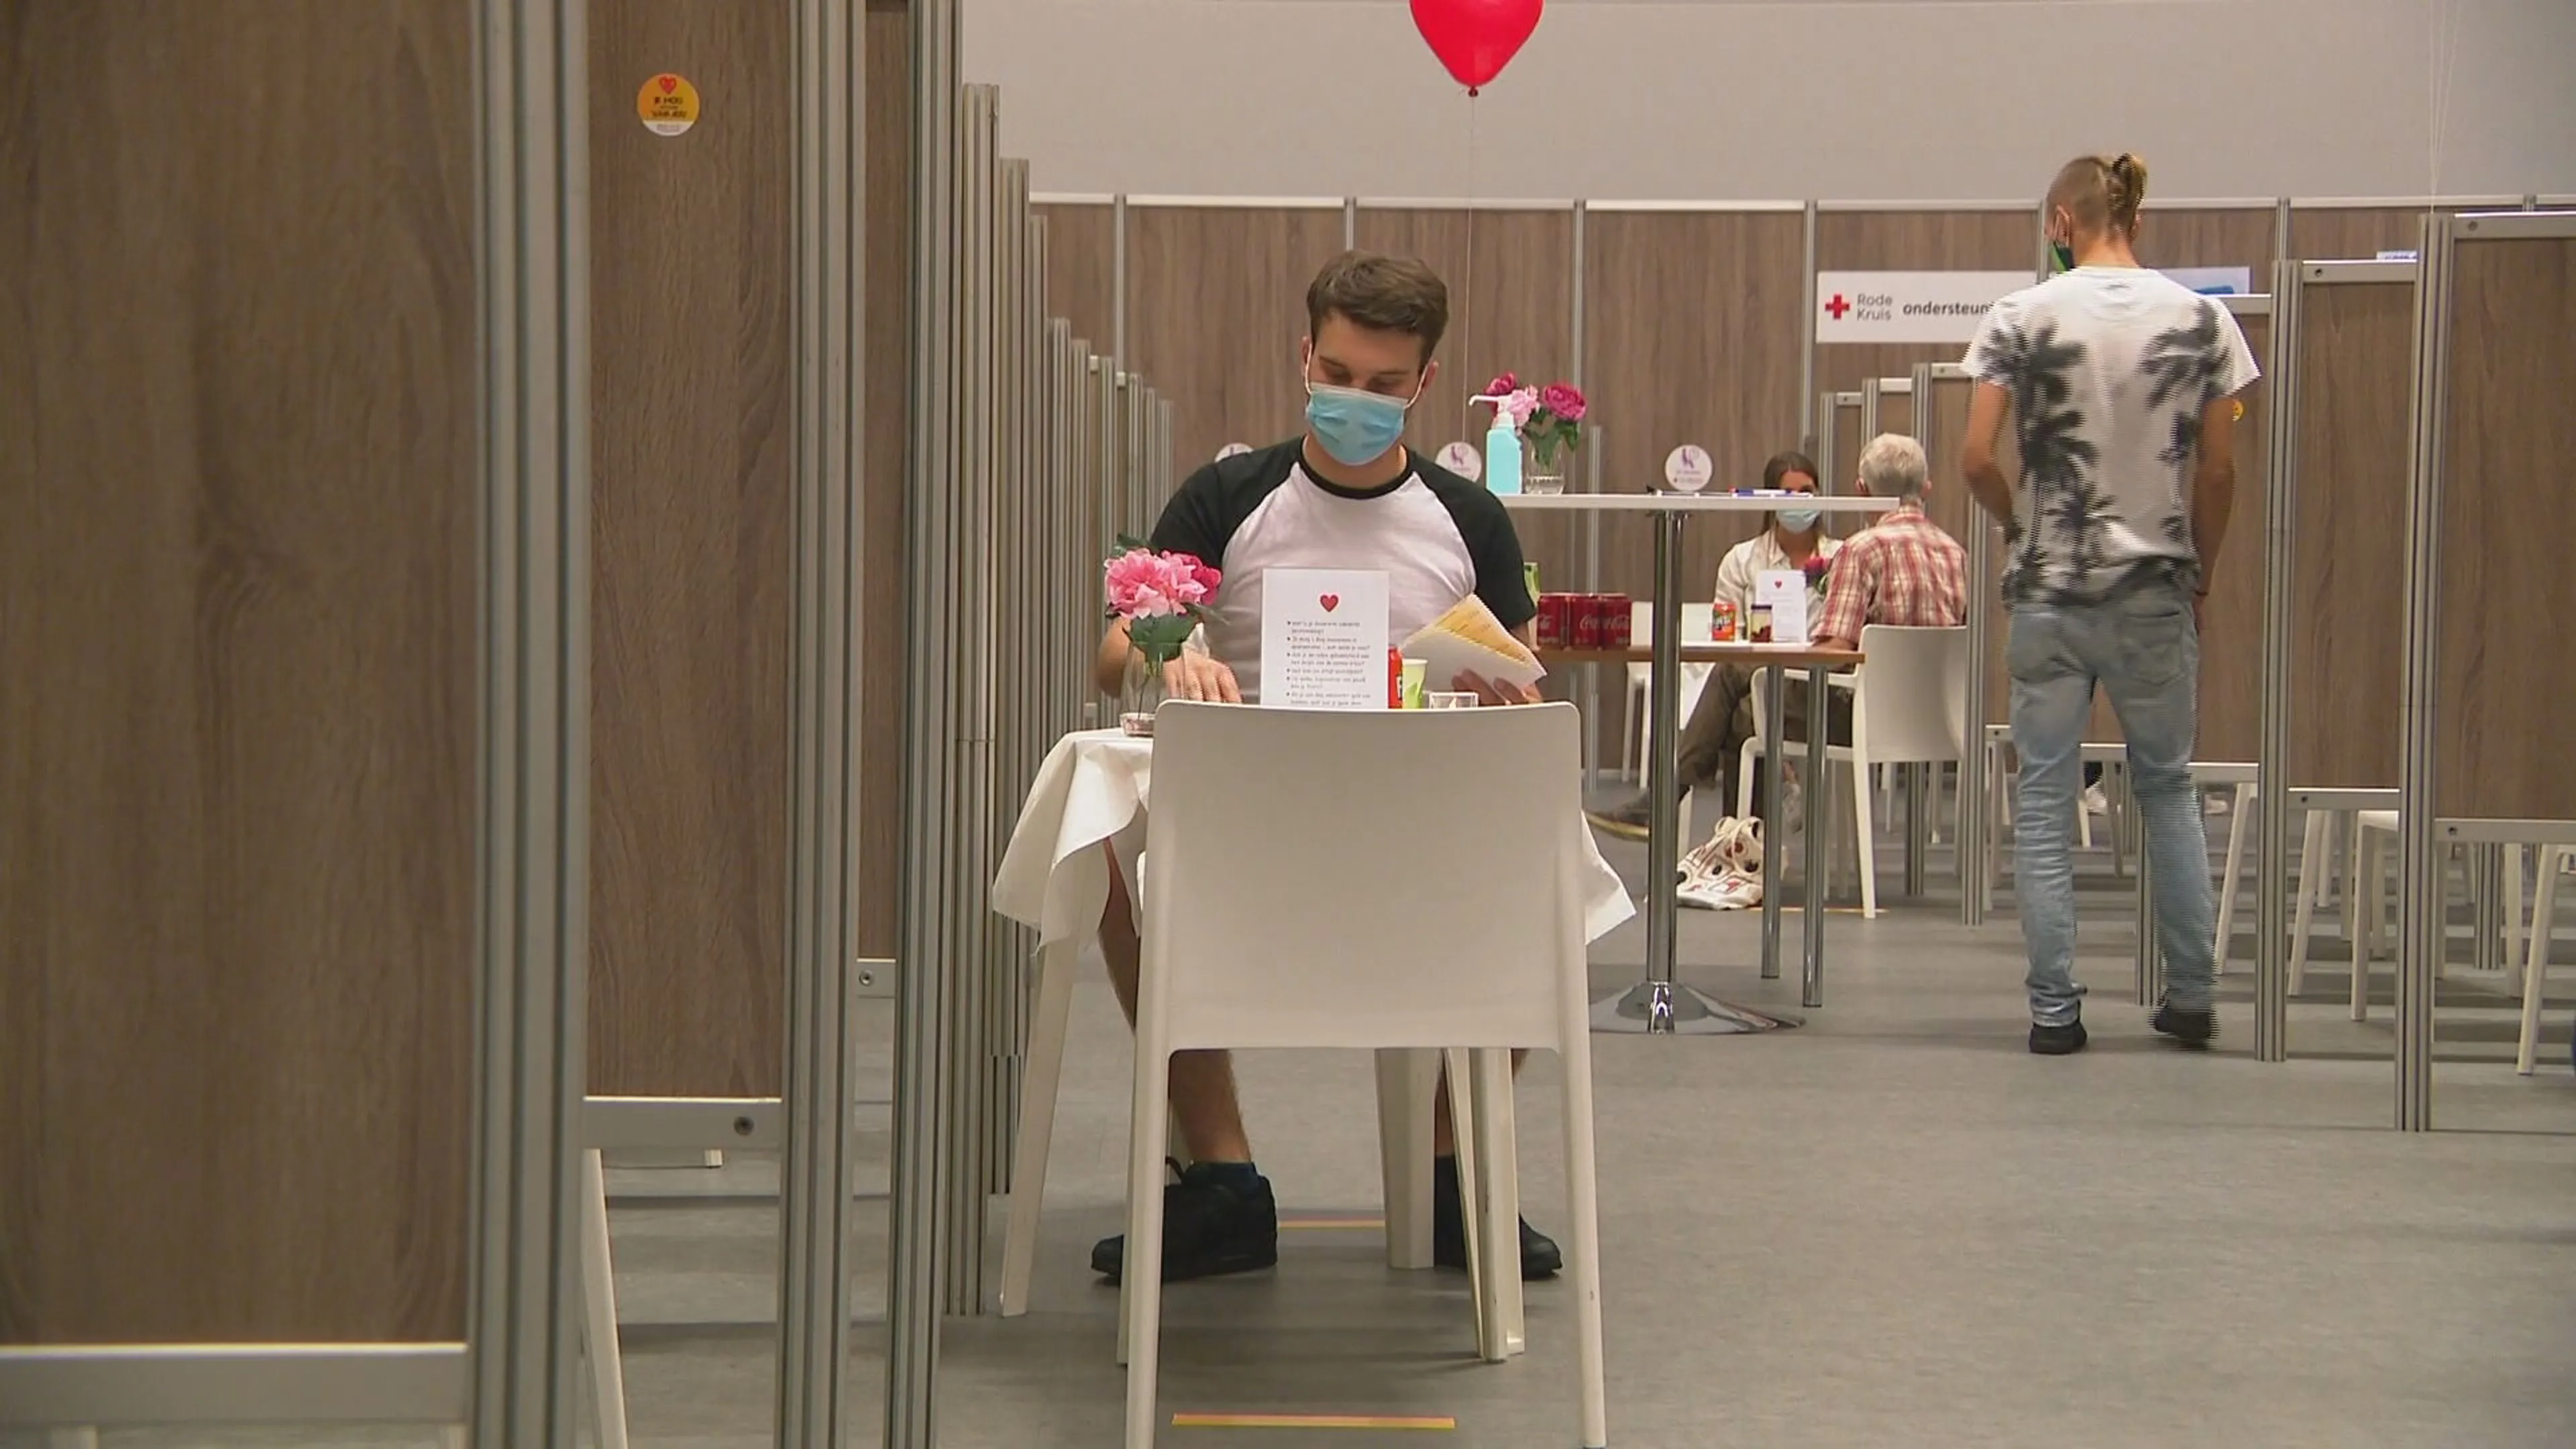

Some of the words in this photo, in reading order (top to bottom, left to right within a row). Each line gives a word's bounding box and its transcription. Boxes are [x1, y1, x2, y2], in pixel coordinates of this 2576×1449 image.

[1857, 293, 1892, 306] Rode
[1857, 308, 1892, 321] Kruis
[1902, 301, 1994, 315] ondersteun
